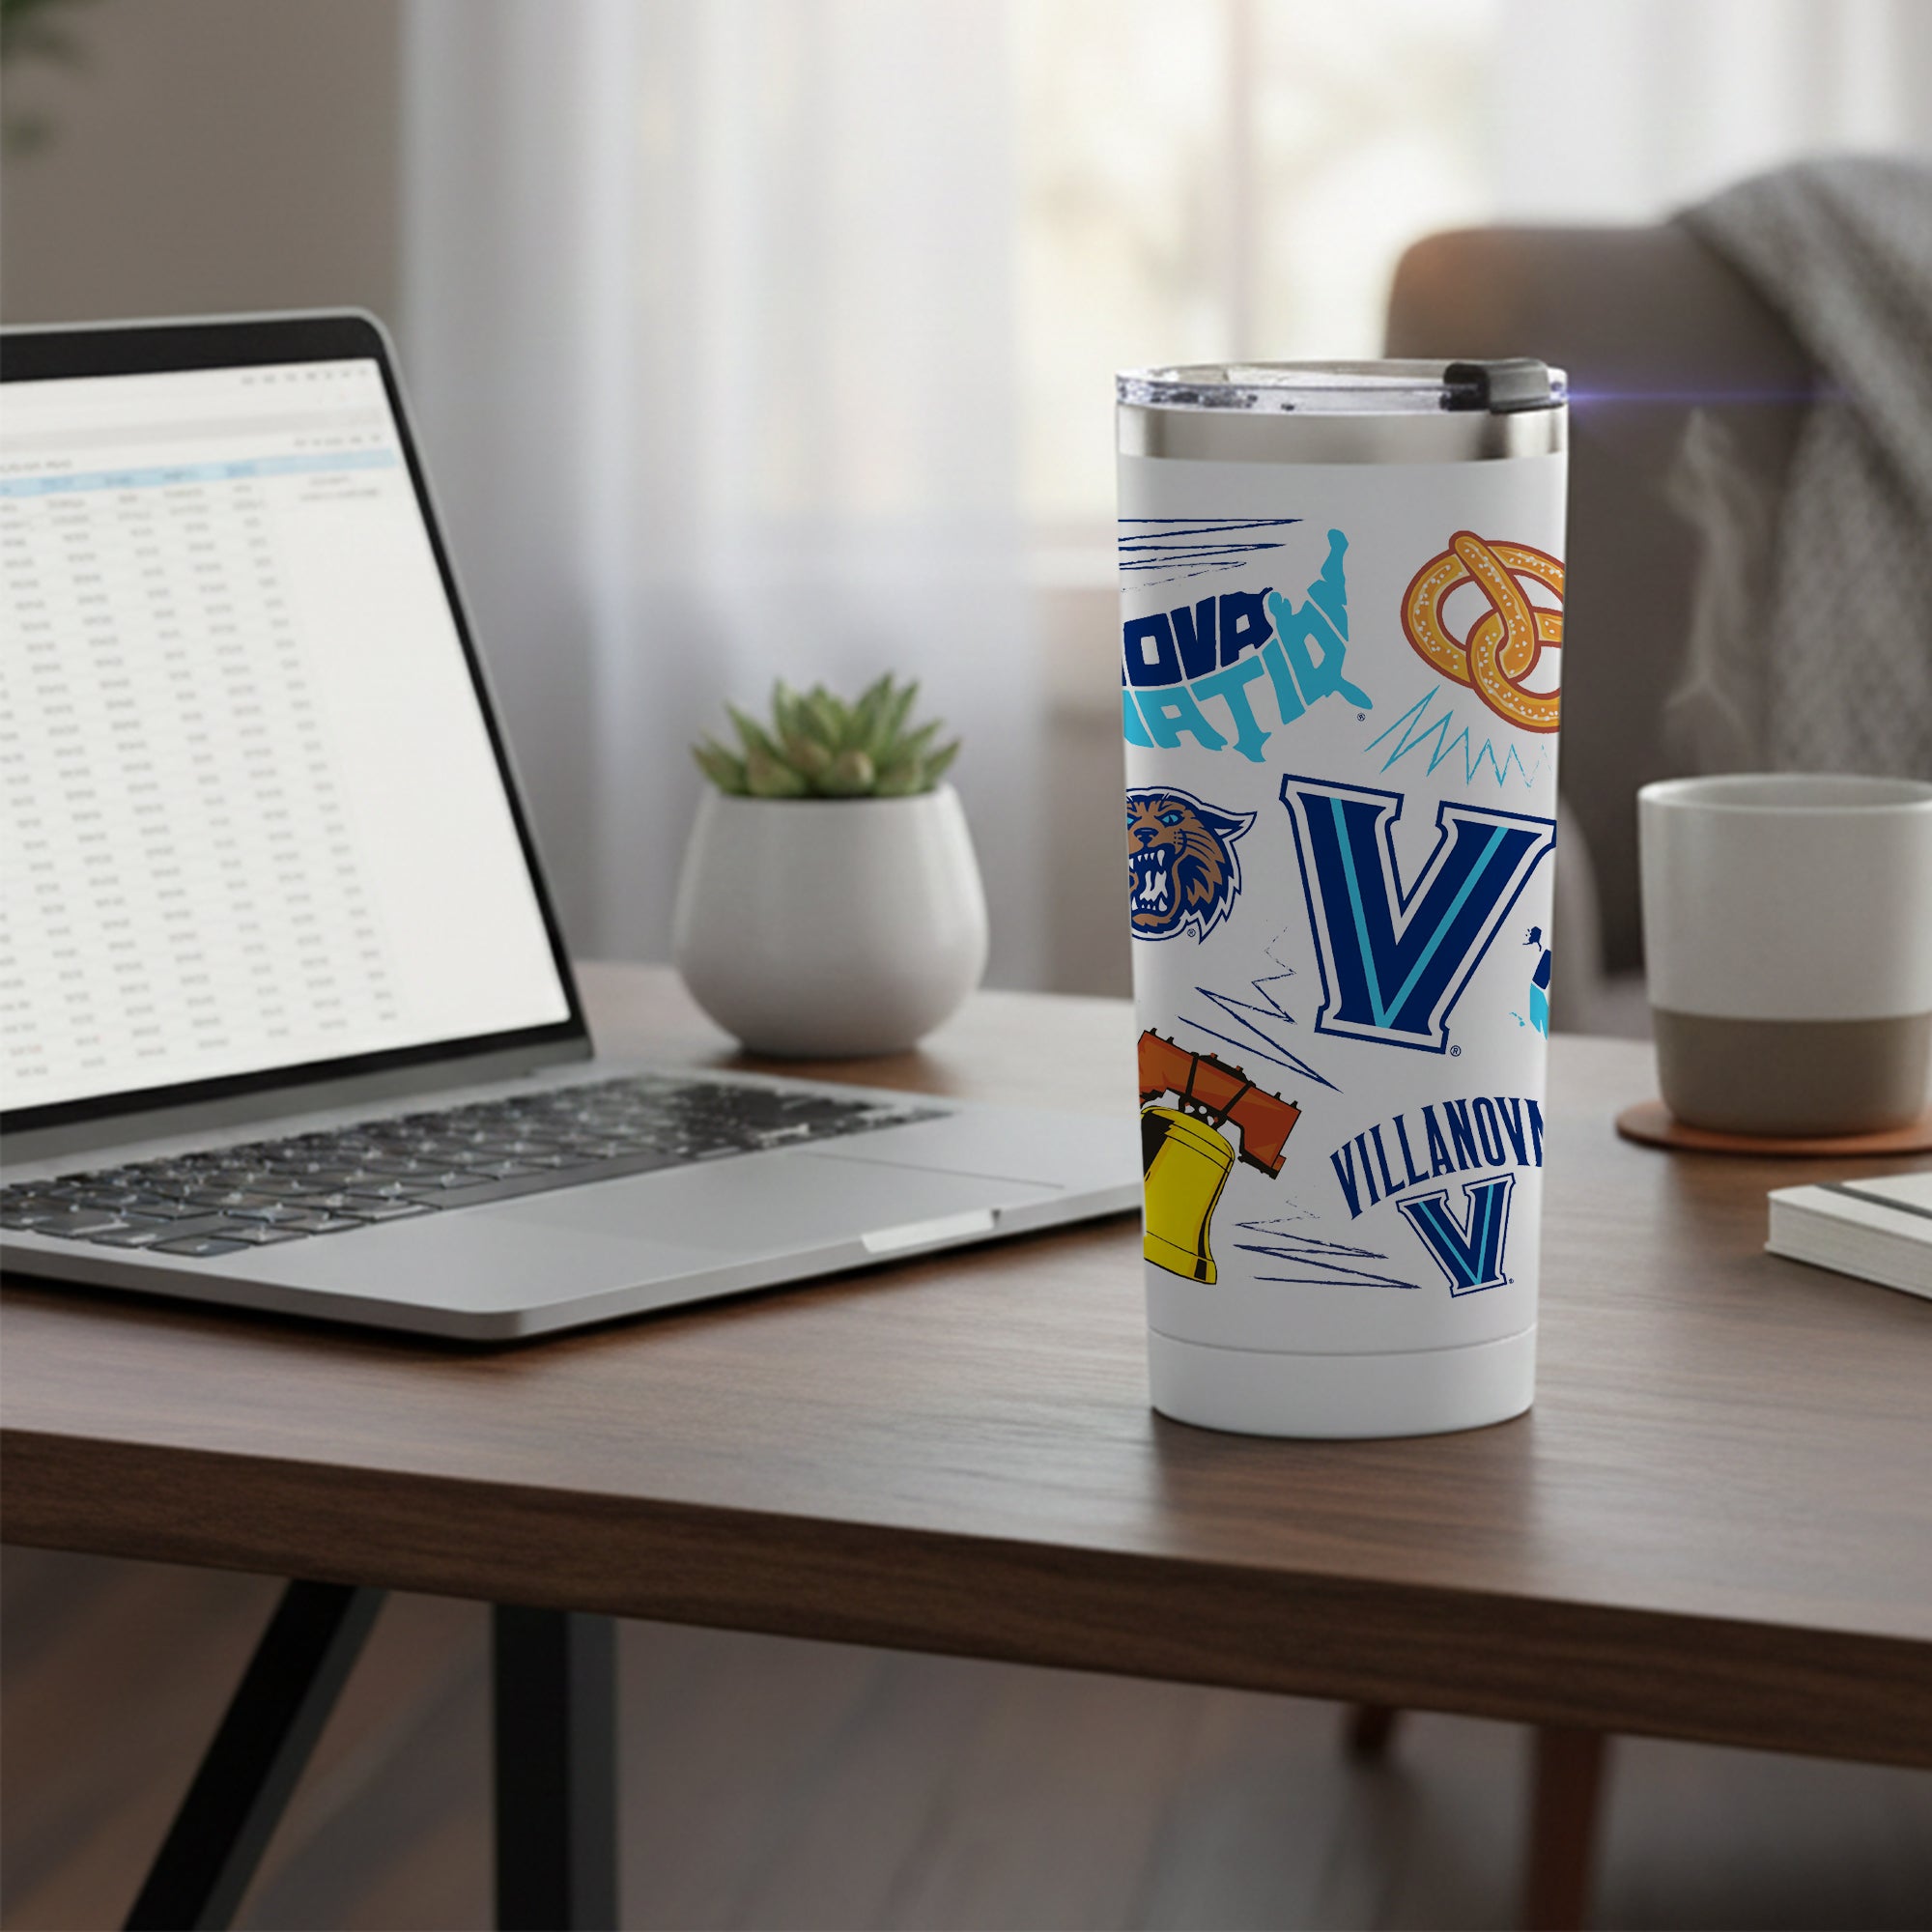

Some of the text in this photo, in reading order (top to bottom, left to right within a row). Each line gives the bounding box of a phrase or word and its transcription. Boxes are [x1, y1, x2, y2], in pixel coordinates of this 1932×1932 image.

[1122, 587, 1273, 687] OVA
[1279, 774, 1557, 1054] V
[1396, 1173, 1516, 1298] V
